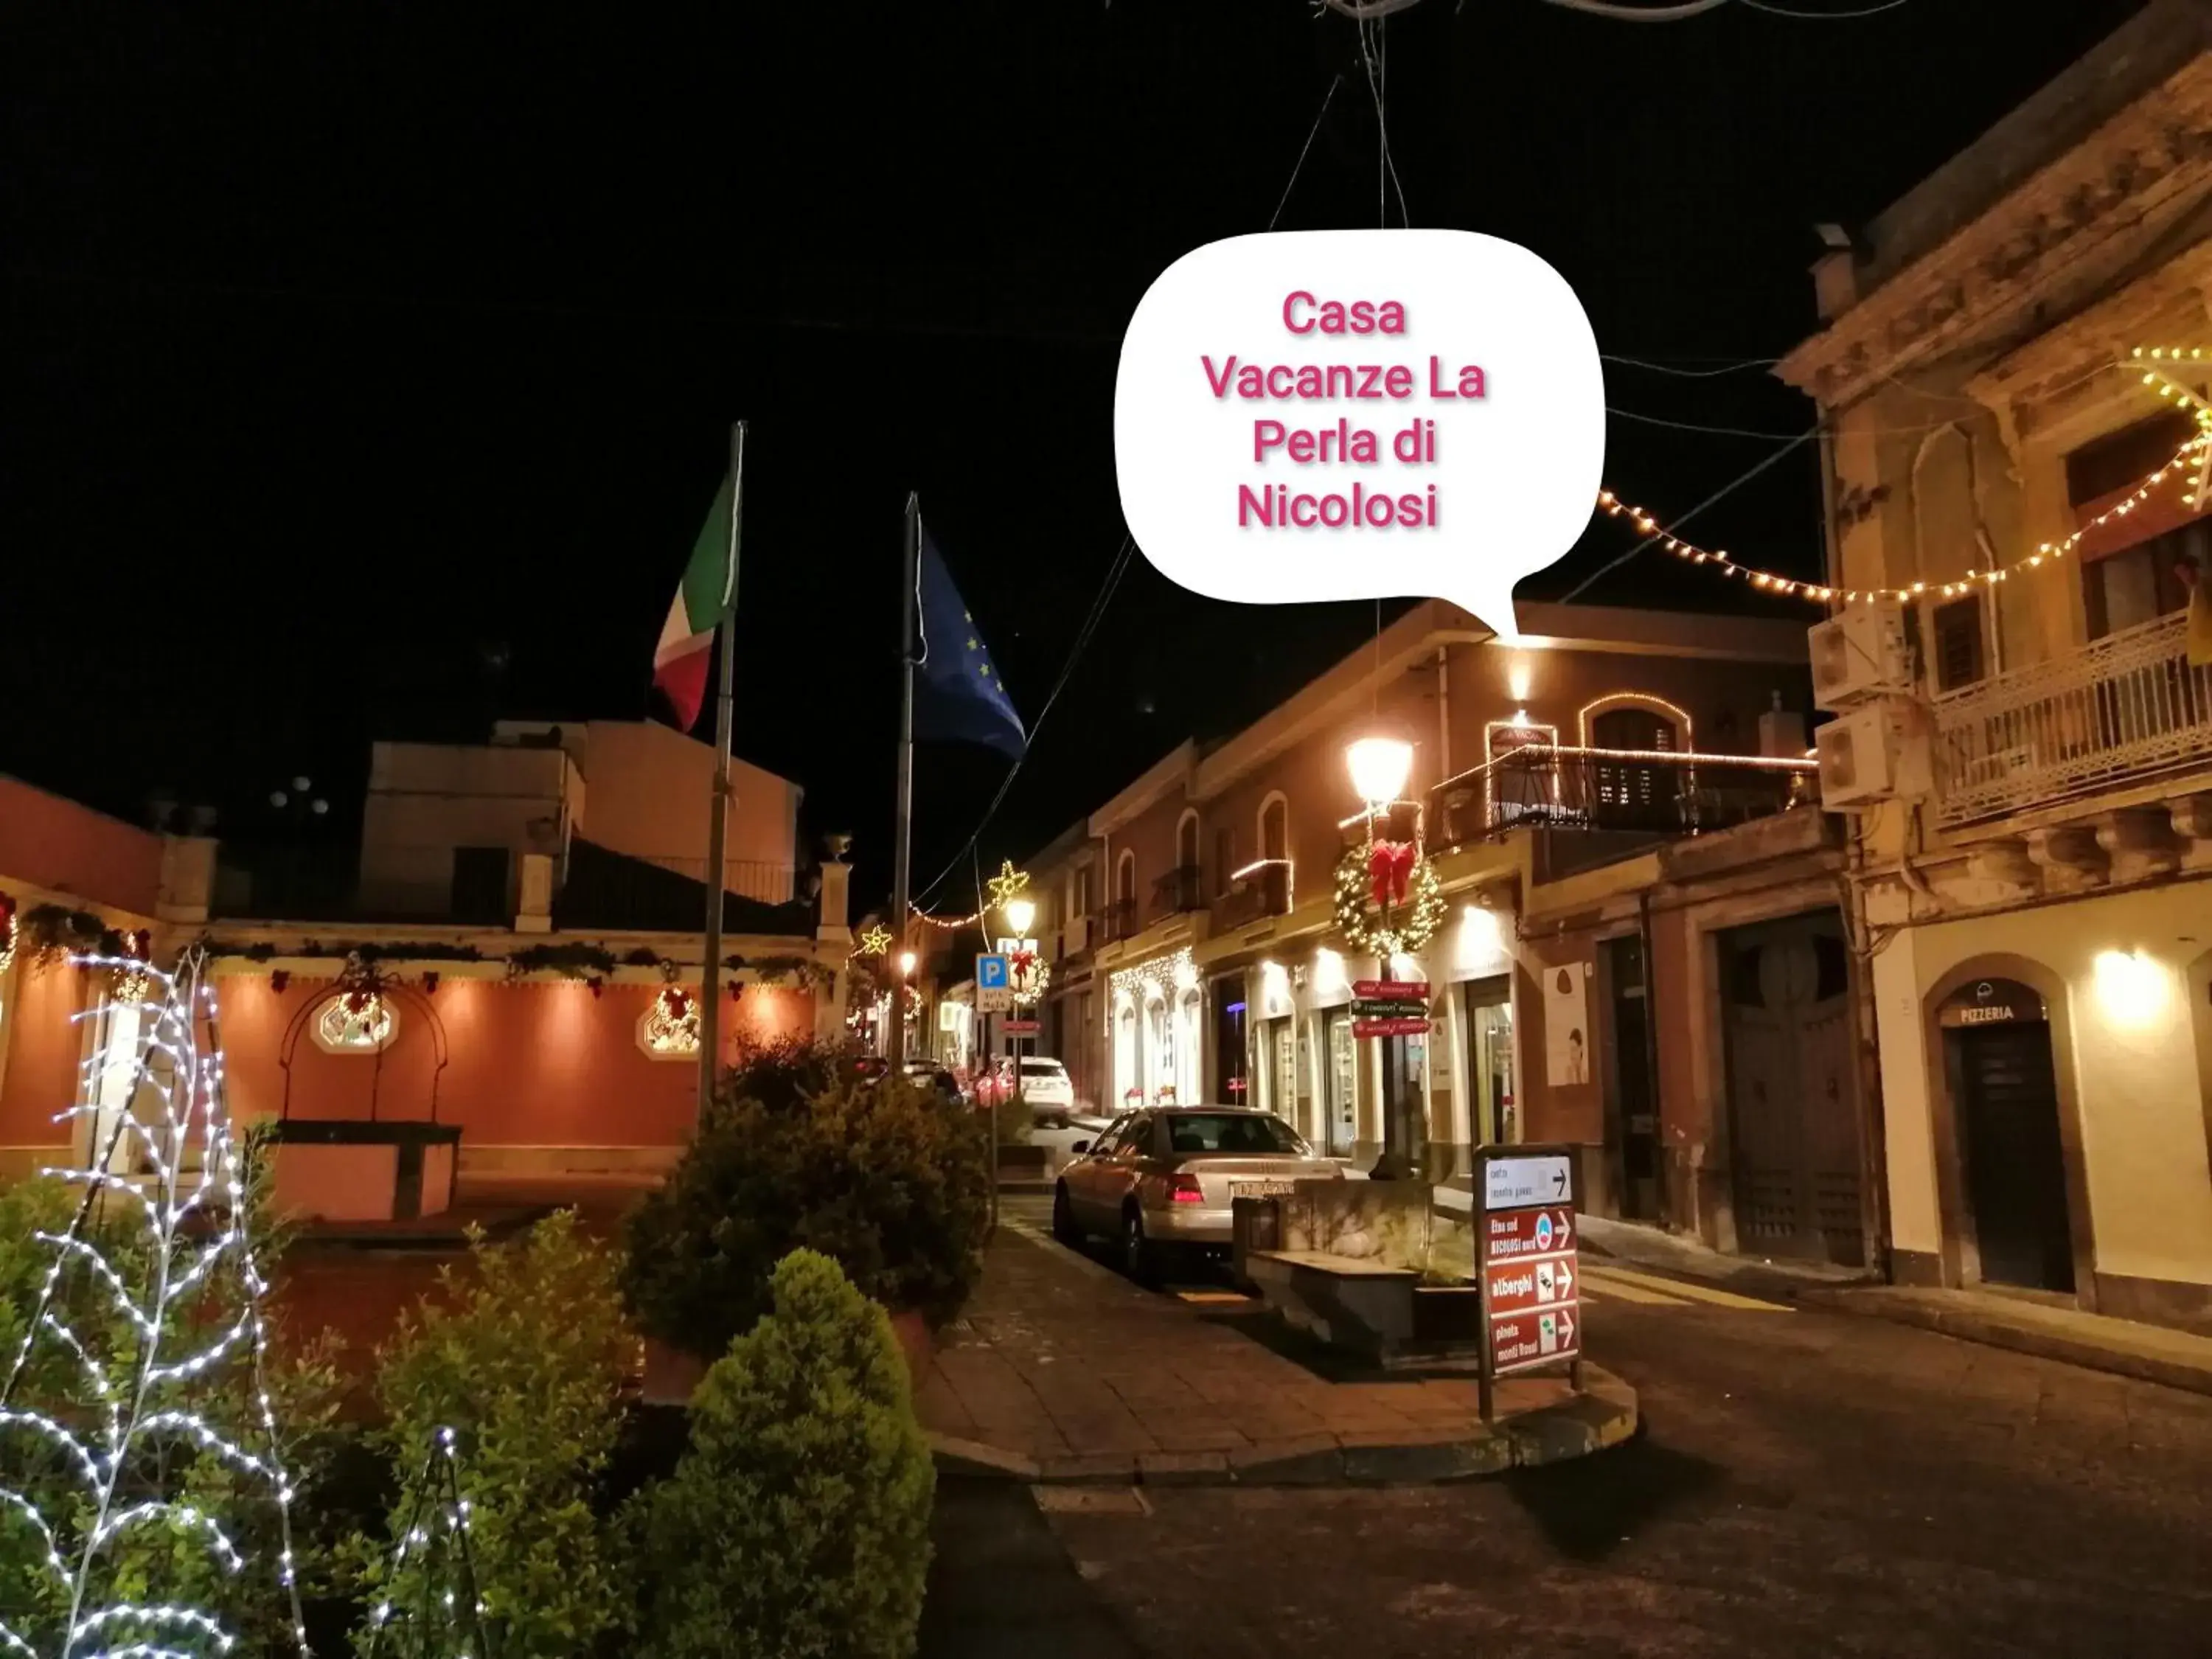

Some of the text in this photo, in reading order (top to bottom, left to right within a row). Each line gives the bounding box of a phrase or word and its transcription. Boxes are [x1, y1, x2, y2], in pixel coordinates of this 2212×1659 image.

[986, 961, 1000, 984] P
[1961, 1006, 2014, 1023] PIZZERIA
[1492, 1274, 1532, 1297] alberghi
